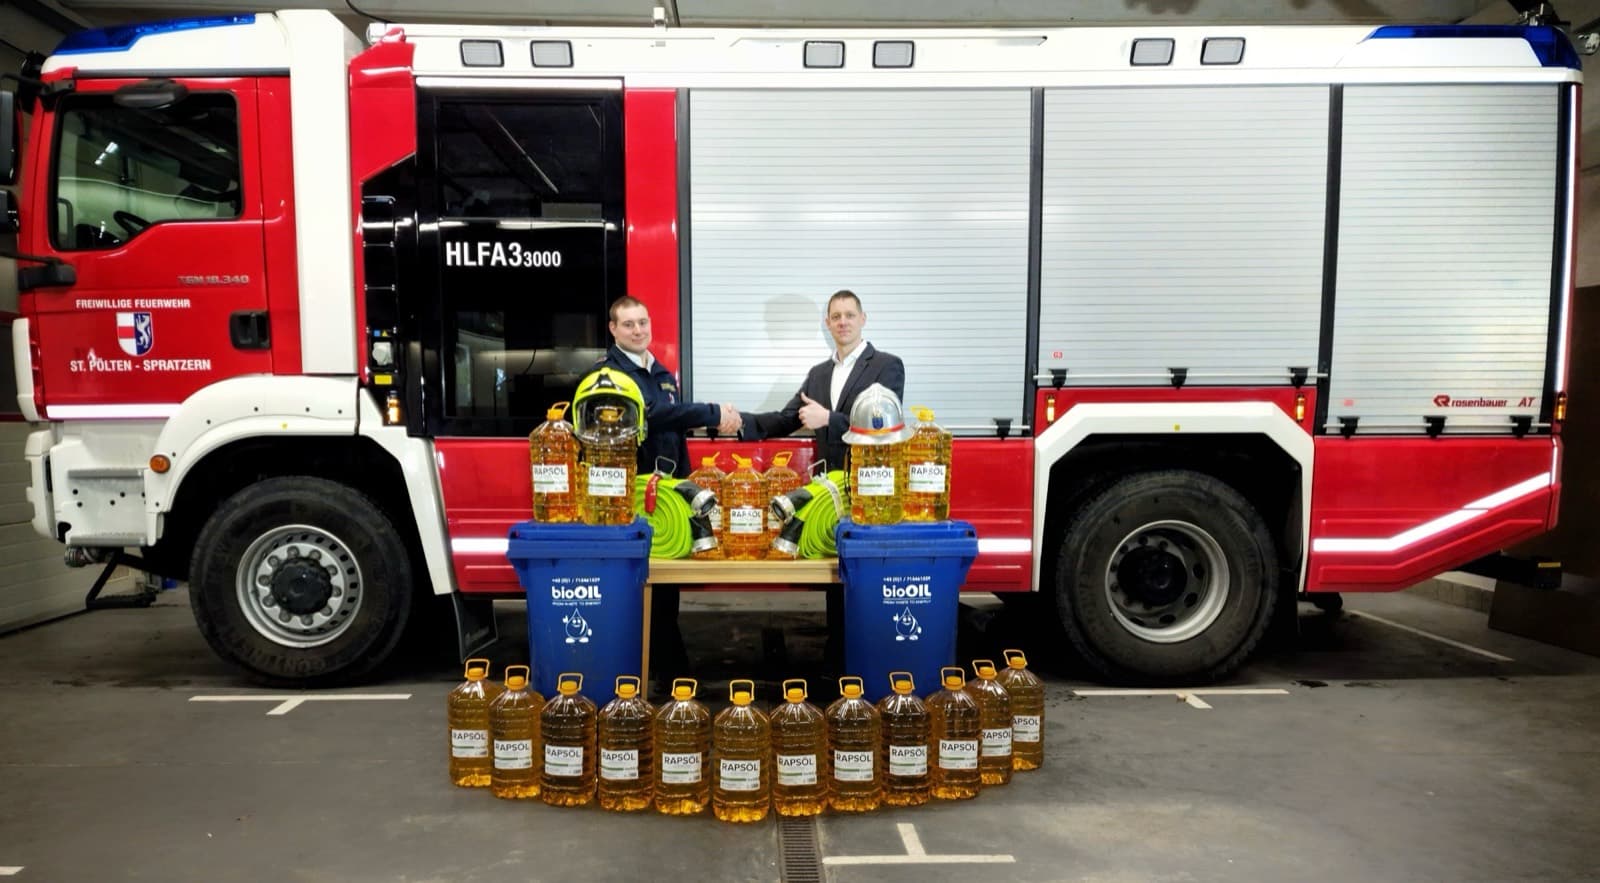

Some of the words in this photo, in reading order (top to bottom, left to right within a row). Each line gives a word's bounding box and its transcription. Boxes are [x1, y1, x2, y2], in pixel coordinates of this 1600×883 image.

[76, 299, 132, 309] FREIWILLIGE
[135, 299, 191, 308] FEUERWEHR
[70, 360, 86, 372] ST.
[89, 357, 132, 371] PÖLTEN
[143, 359, 212, 371] SPRATZERN
[1451, 397, 1508, 407] rosenbauer
[1518, 397, 1536, 407] AT
[552, 586, 602, 599] bioOIL
[882, 584, 932, 598] bioOIL
[1013, 717, 1039, 726] APSÖL
[664, 755, 700, 765] RAPSÖL
[722, 762, 758, 771] RAPSÖL
